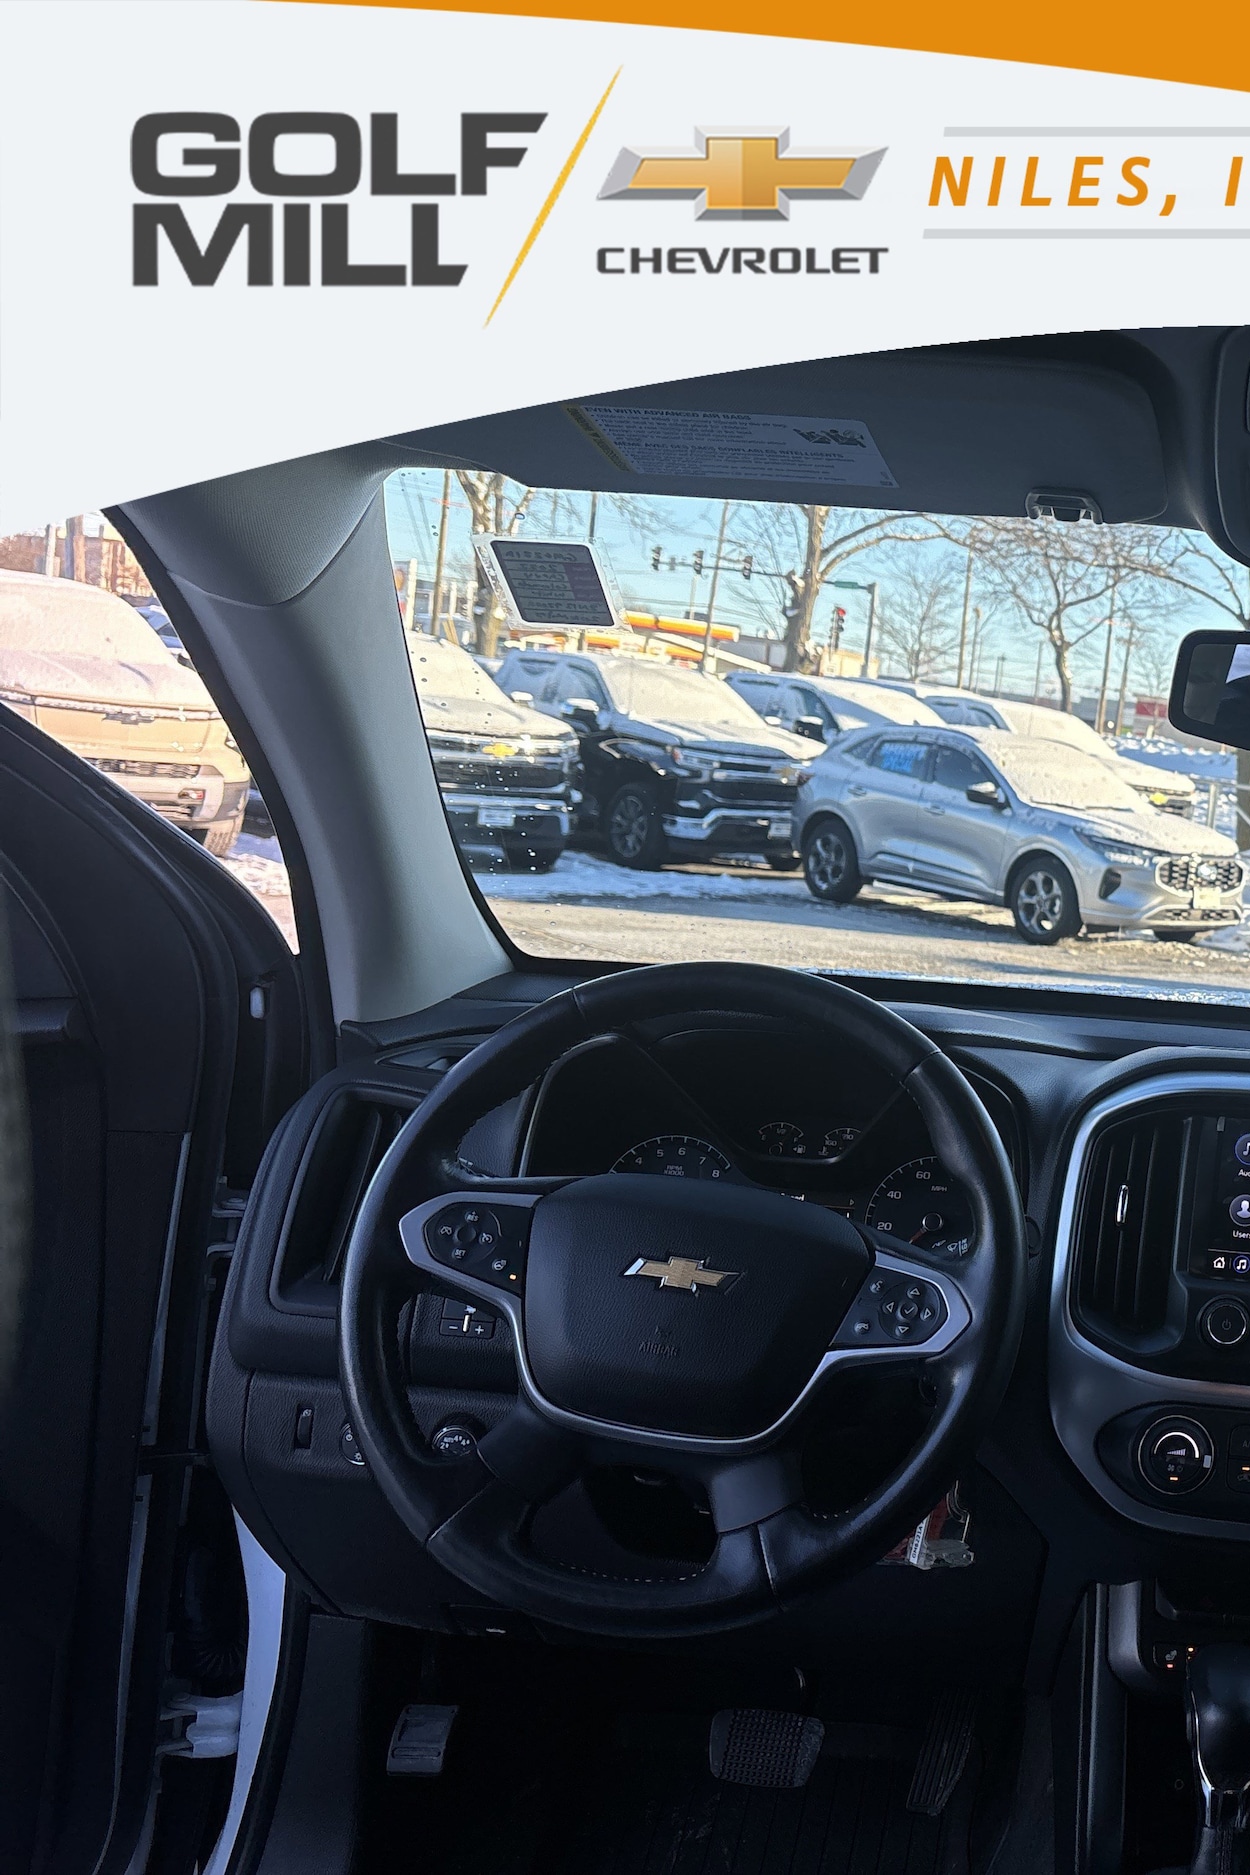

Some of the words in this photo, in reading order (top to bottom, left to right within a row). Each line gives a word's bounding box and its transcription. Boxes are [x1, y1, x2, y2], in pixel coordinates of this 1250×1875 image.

[656, 1149, 664, 1157] 5
[678, 1147, 686, 1155] 6
[635, 1157, 643, 1165] 4
[699, 1156, 707, 1165] 7
[712, 1169, 720, 1178] 8
[916, 1171, 931, 1180] 60
[887, 1191, 902, 1199] 40
[877, 1222, 892, 1231] 20
